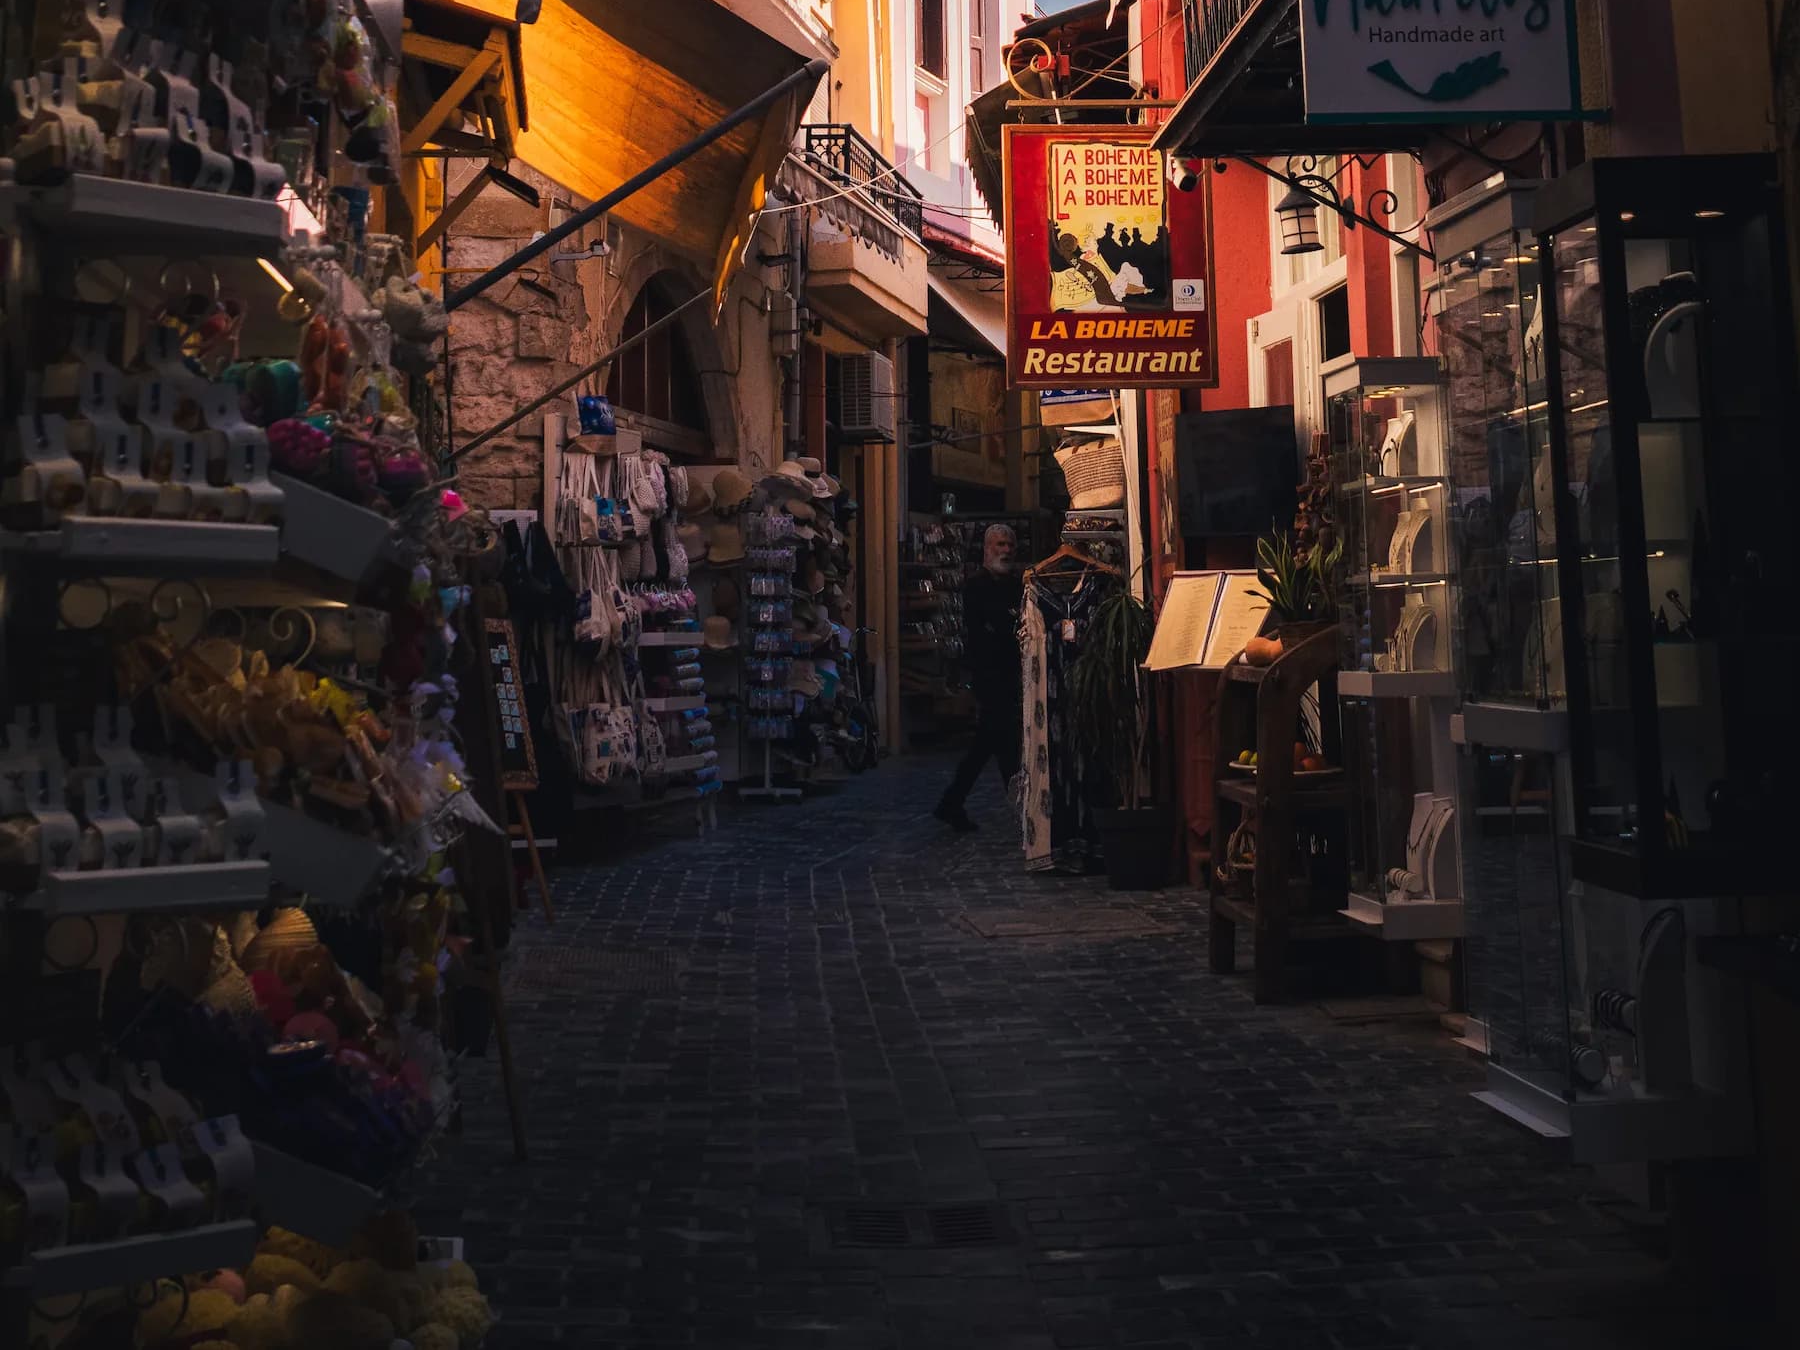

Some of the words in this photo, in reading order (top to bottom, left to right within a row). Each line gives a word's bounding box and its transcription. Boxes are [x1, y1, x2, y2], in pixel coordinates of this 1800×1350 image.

[1369, 26, 1474, 43] Handmade
[1479, 28, 1505, 42] art
[1085, 149, 1158, 166] BOHEME
[1085, 168, 1158, 185] BOHEME
[1085, 189, 1159, 206] BOHEME
[1030, 320, 1069, 340] LA
[1075, 319, 1195, 339] BOHEME
[1023, 347, 1203, 374] Restaurant
